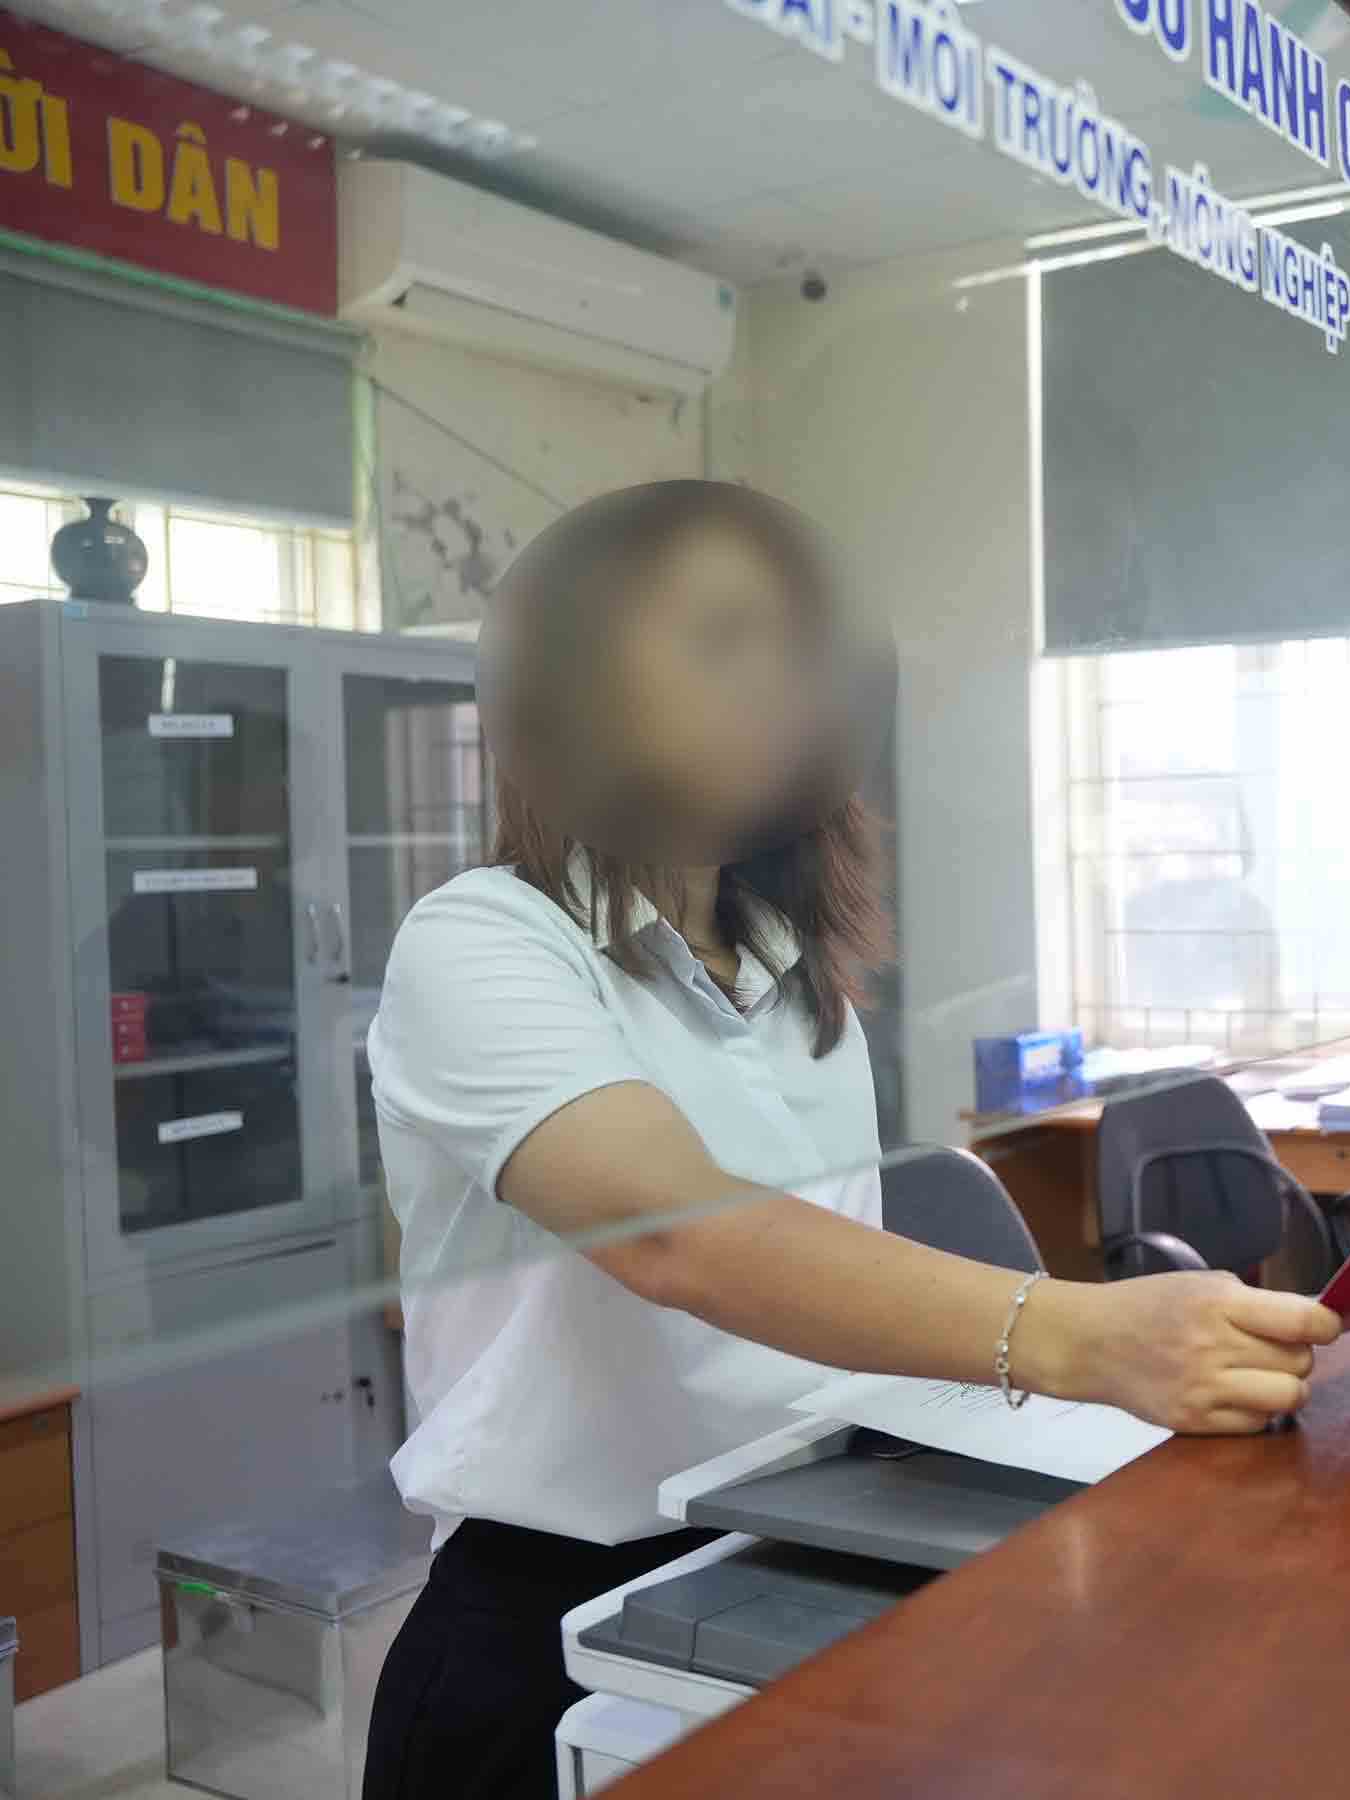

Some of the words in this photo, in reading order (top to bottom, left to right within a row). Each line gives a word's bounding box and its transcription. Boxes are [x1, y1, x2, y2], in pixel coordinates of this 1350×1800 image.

[108, 120, 279, 250] DÂN
[889, 2, 976, 125] MÔI
[1168, 172, 1257, 283] NÔNG
[1263, 232, 1350, 347] NGHIỆP
